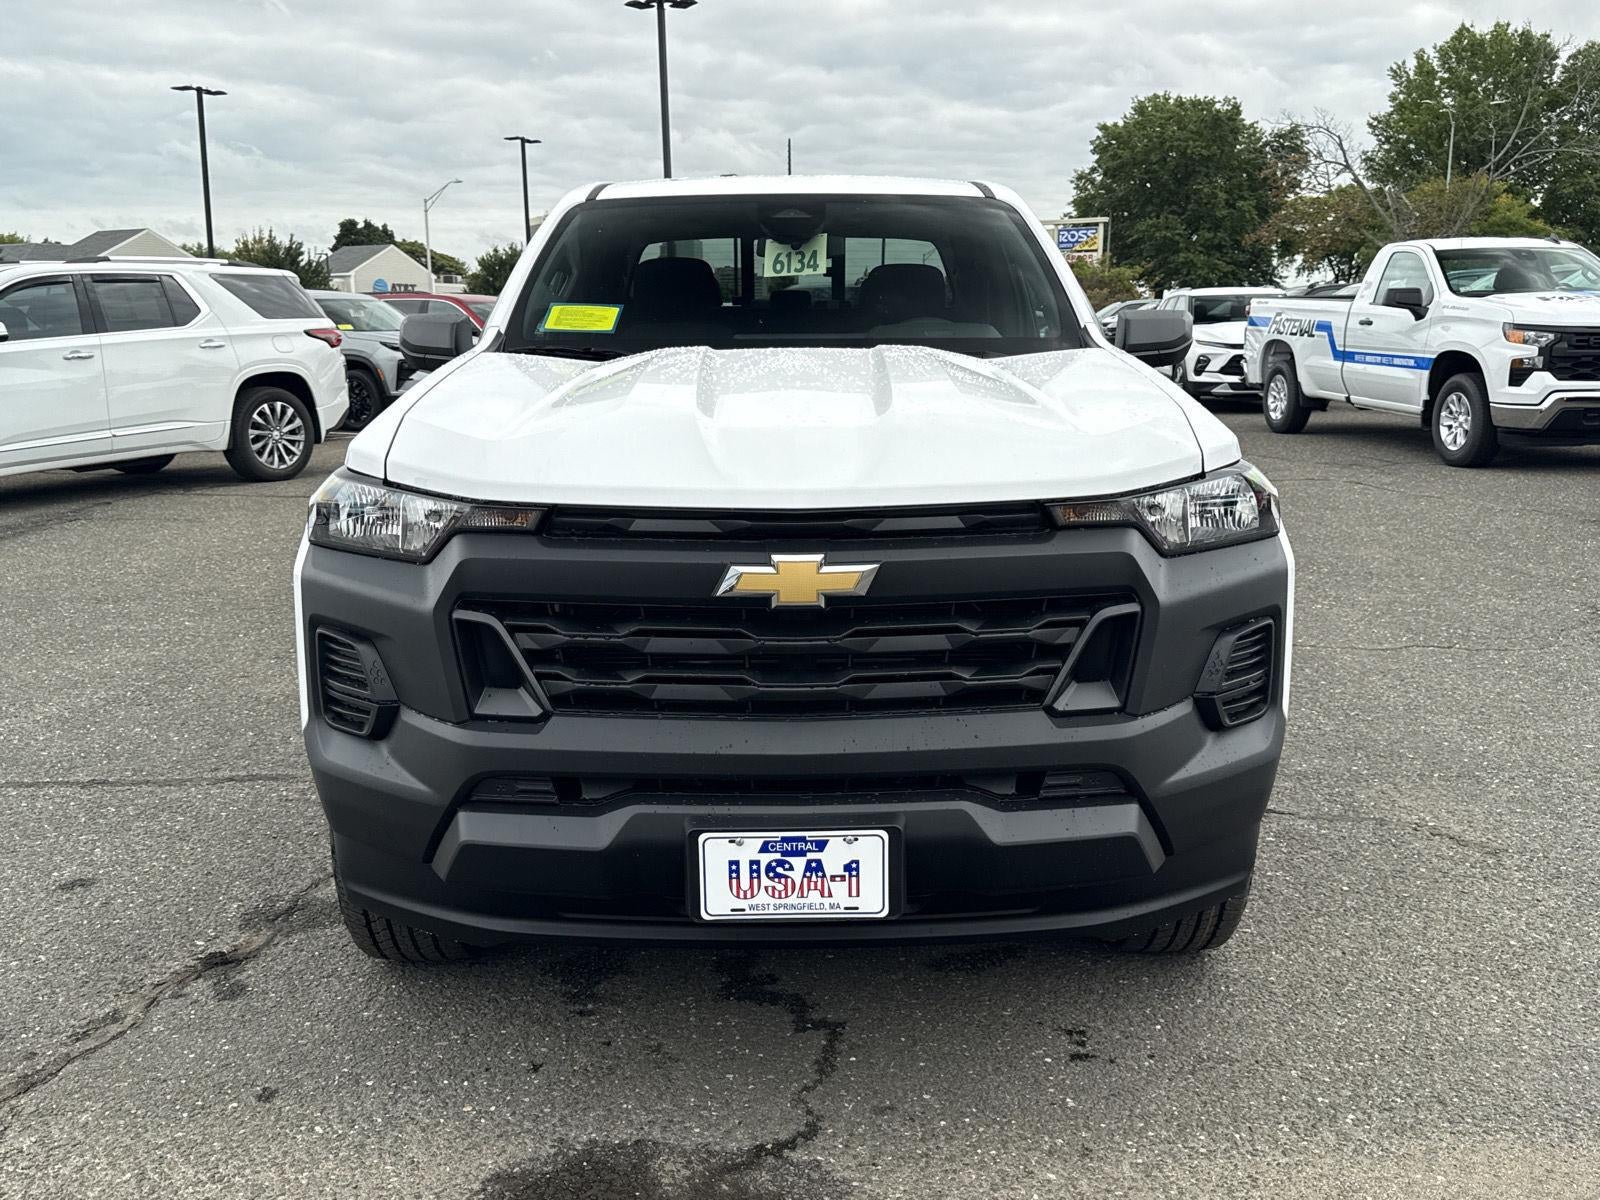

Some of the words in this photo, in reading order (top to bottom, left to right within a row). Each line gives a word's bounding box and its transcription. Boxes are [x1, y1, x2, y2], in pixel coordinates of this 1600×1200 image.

[772, 249, 819, 274] 6134
[390, 282, 417, 293] AT&T
[1267, 311, 1316, 338] FASTENAL
[768, 842, 818, 851] CENTRAL
[728, 858, 860, 900] USA-1
[748, 903, 771, 912] WEST
[772, 902, 827, 912] SPRINGFIELD,
[828, 902, 841, 911] MA
